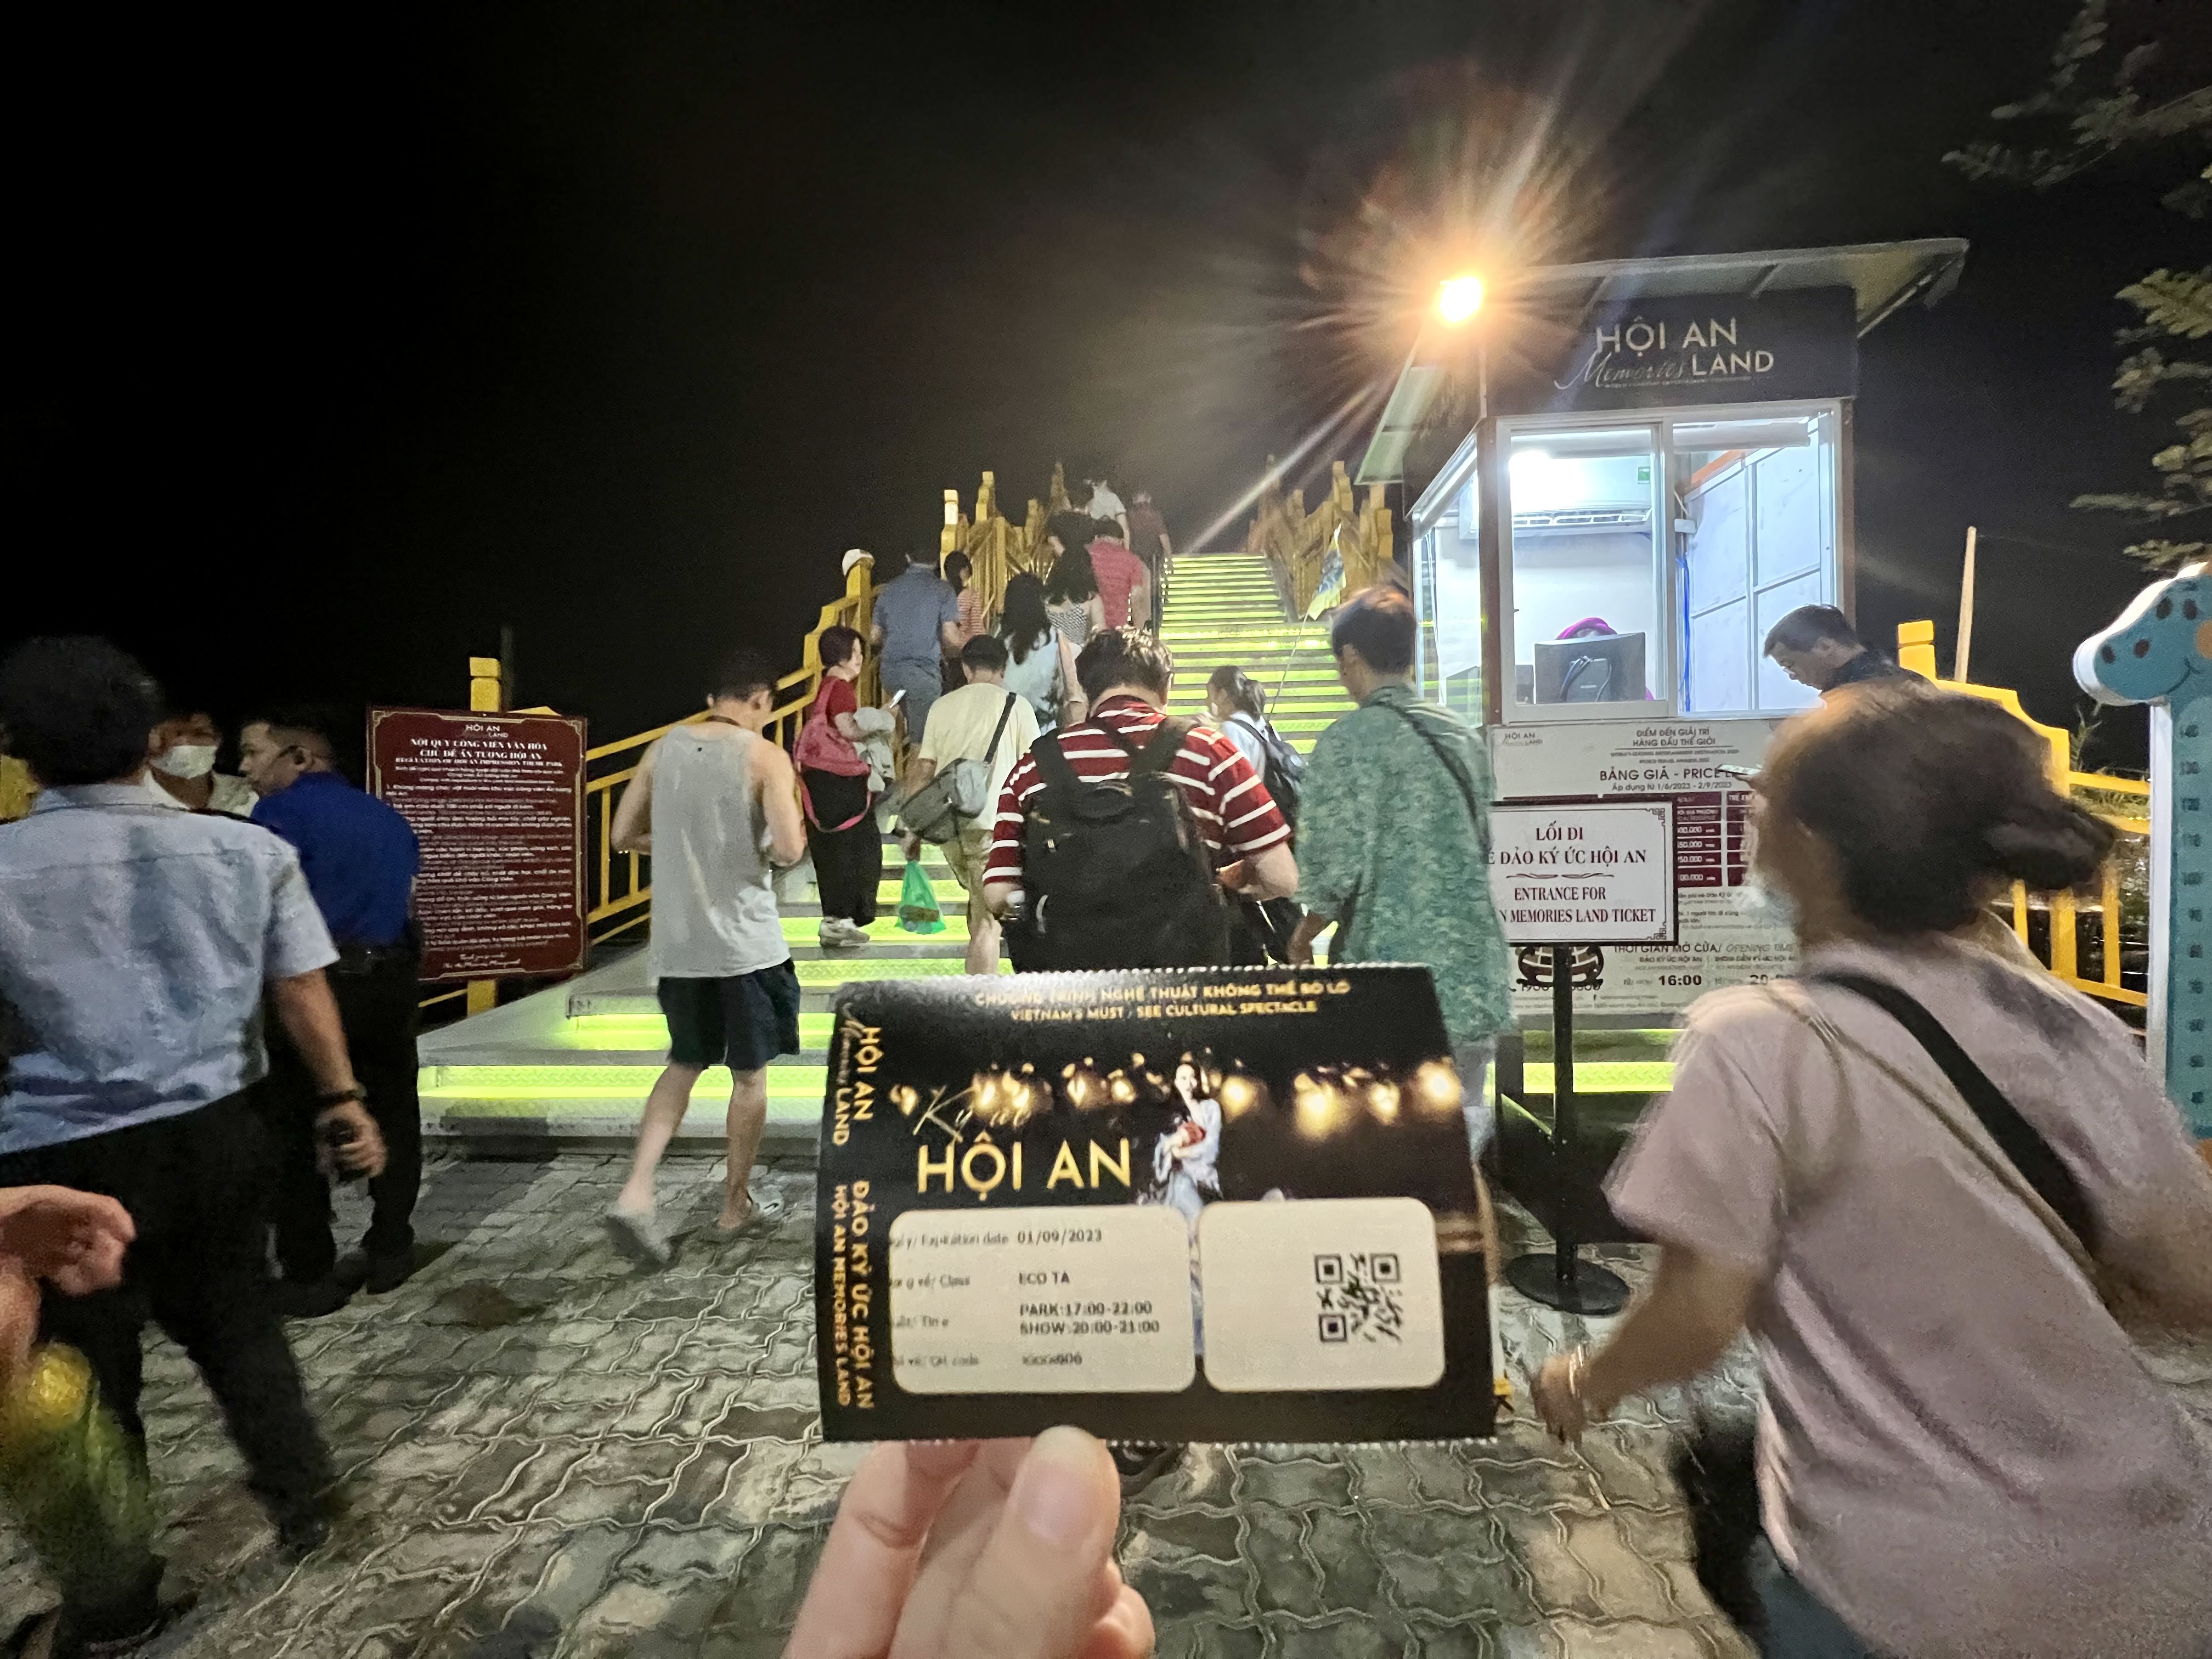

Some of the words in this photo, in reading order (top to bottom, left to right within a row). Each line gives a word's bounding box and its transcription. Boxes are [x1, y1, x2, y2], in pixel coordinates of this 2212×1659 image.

[1597, 316, 1665, 357] HỘI
[1683, 317, 1736, 348] AN
[1692, 351, 1773, 376] LAND
[1600, 766, 1639, 781] BẢNG
[1644, 766, 1669, 780] GIÁ
[1536, 821, 1562, 840] LỐI
[1568, 827, 1583, 840] ĐI
[1500, 847, 1533, 865] ĐẢO
[1539, 847, 1559, 864] KÝ
[1565, 847, 1585, 864] ỨC
[1591, 845, 1618, 867] HỘI
[1624, 850, 1646, 863] AN
[1515, 887, 1578, 900] ENTRANCE
[1583, 887, 1606, 900] FOR
[1511, 909, 1572, 923] MEMORIES
[1577, 909, 1608, 922] LAND
[1612, 909, 1656, 922] TICKET
[1659, 975, 1702, 986] 16:00
[1166, 1003, 1237, 1017] CULTURAL
[853, 1081, 875, 1120] AN
[832, 1088, 852, 1146] LAND
[917, 1130, 1023, 1201] HỘI
[1047, 1137, 1131, 1189] AN
[1017, 1228, 1102, 1246] 01/09/2023
[1054, 1272, 1070, 1284] TA
[856, 1375, 875, 1409] AN
